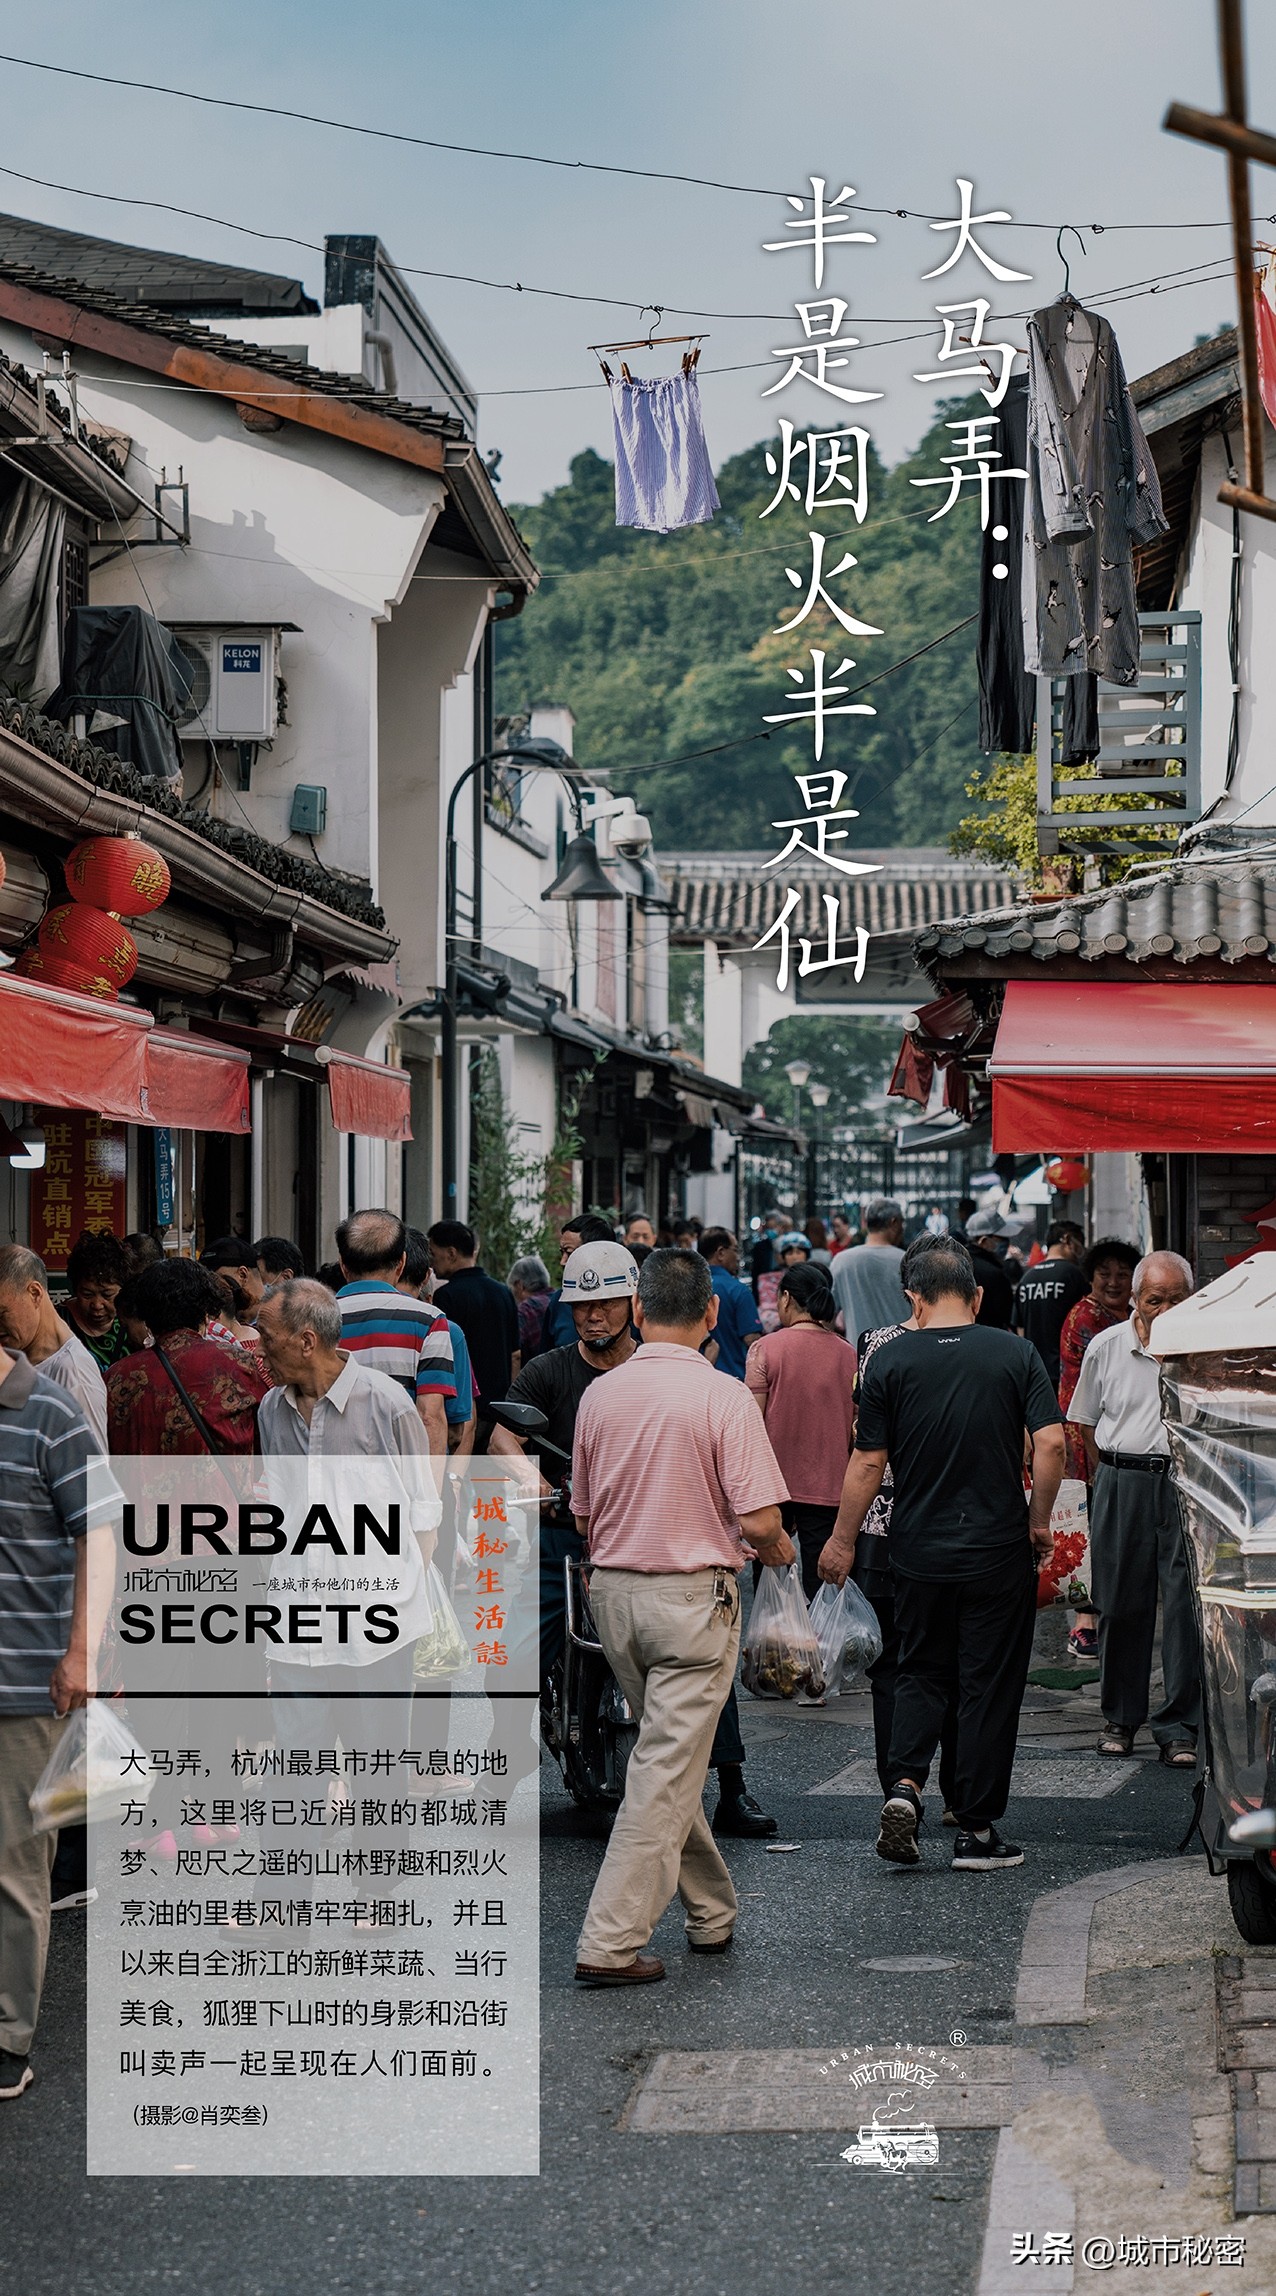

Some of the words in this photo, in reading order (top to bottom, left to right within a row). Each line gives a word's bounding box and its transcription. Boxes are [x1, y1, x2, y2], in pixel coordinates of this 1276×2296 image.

[224, 649, 259, 658] KELON
[42, 1123, 73, 1255] 驻杭直销点
[158, 1128, 171, 1220] 大马弄15号
[1019, 1282, 1066, 1303] STAFF
